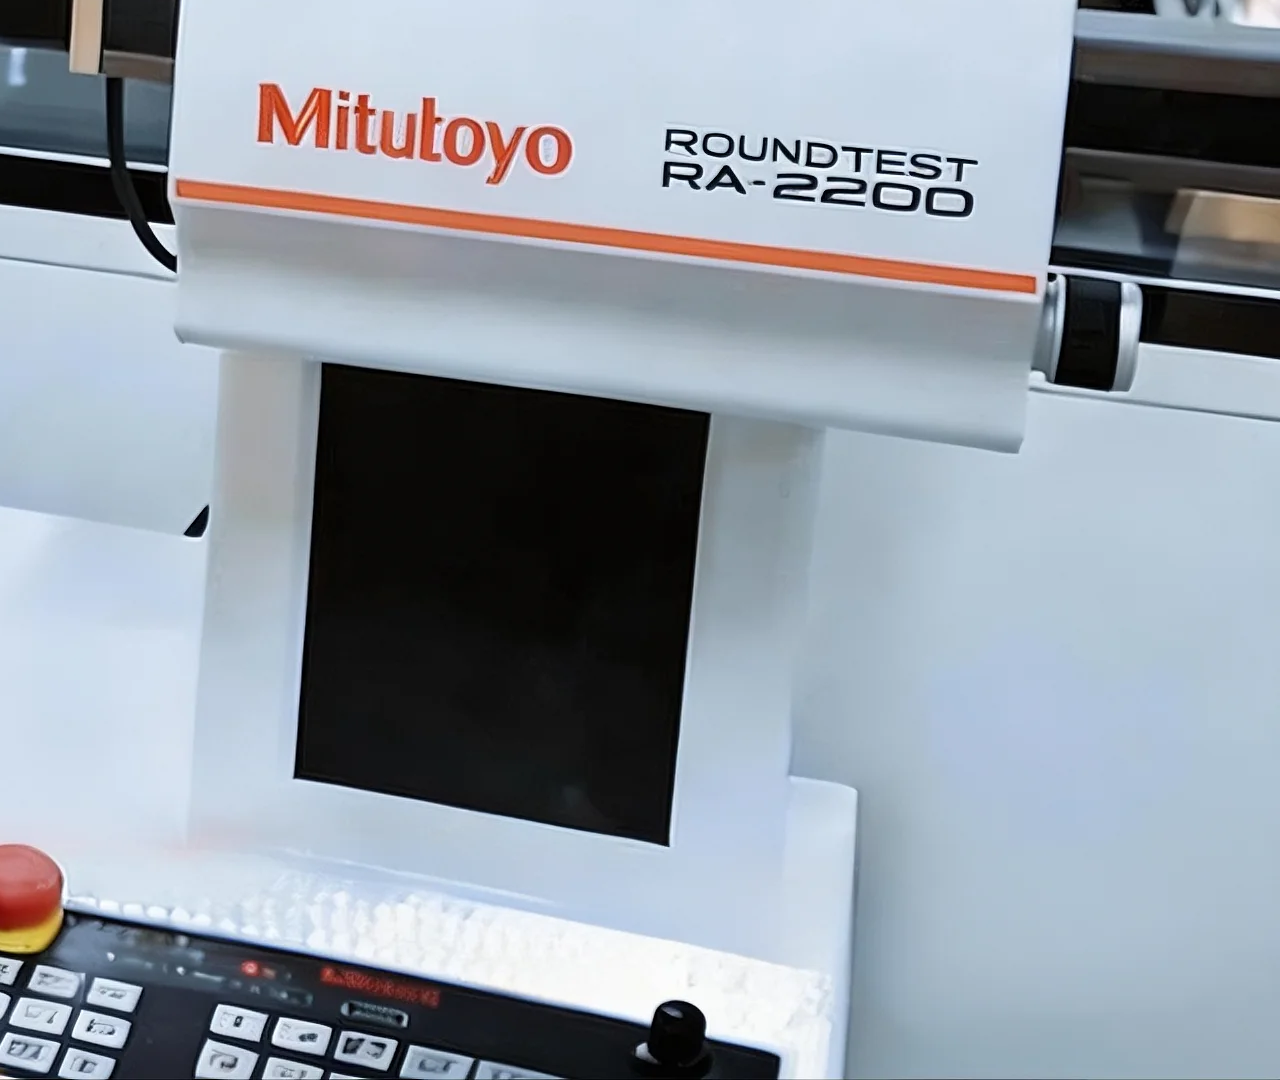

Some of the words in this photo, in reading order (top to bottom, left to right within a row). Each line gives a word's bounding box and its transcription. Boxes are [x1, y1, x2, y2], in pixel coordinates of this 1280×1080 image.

[256, 82, 573, 186] Mitutoyo
[663, 127, 980, 183] ROUNDTEST
[661, 160, 975, 219] RA-2200
